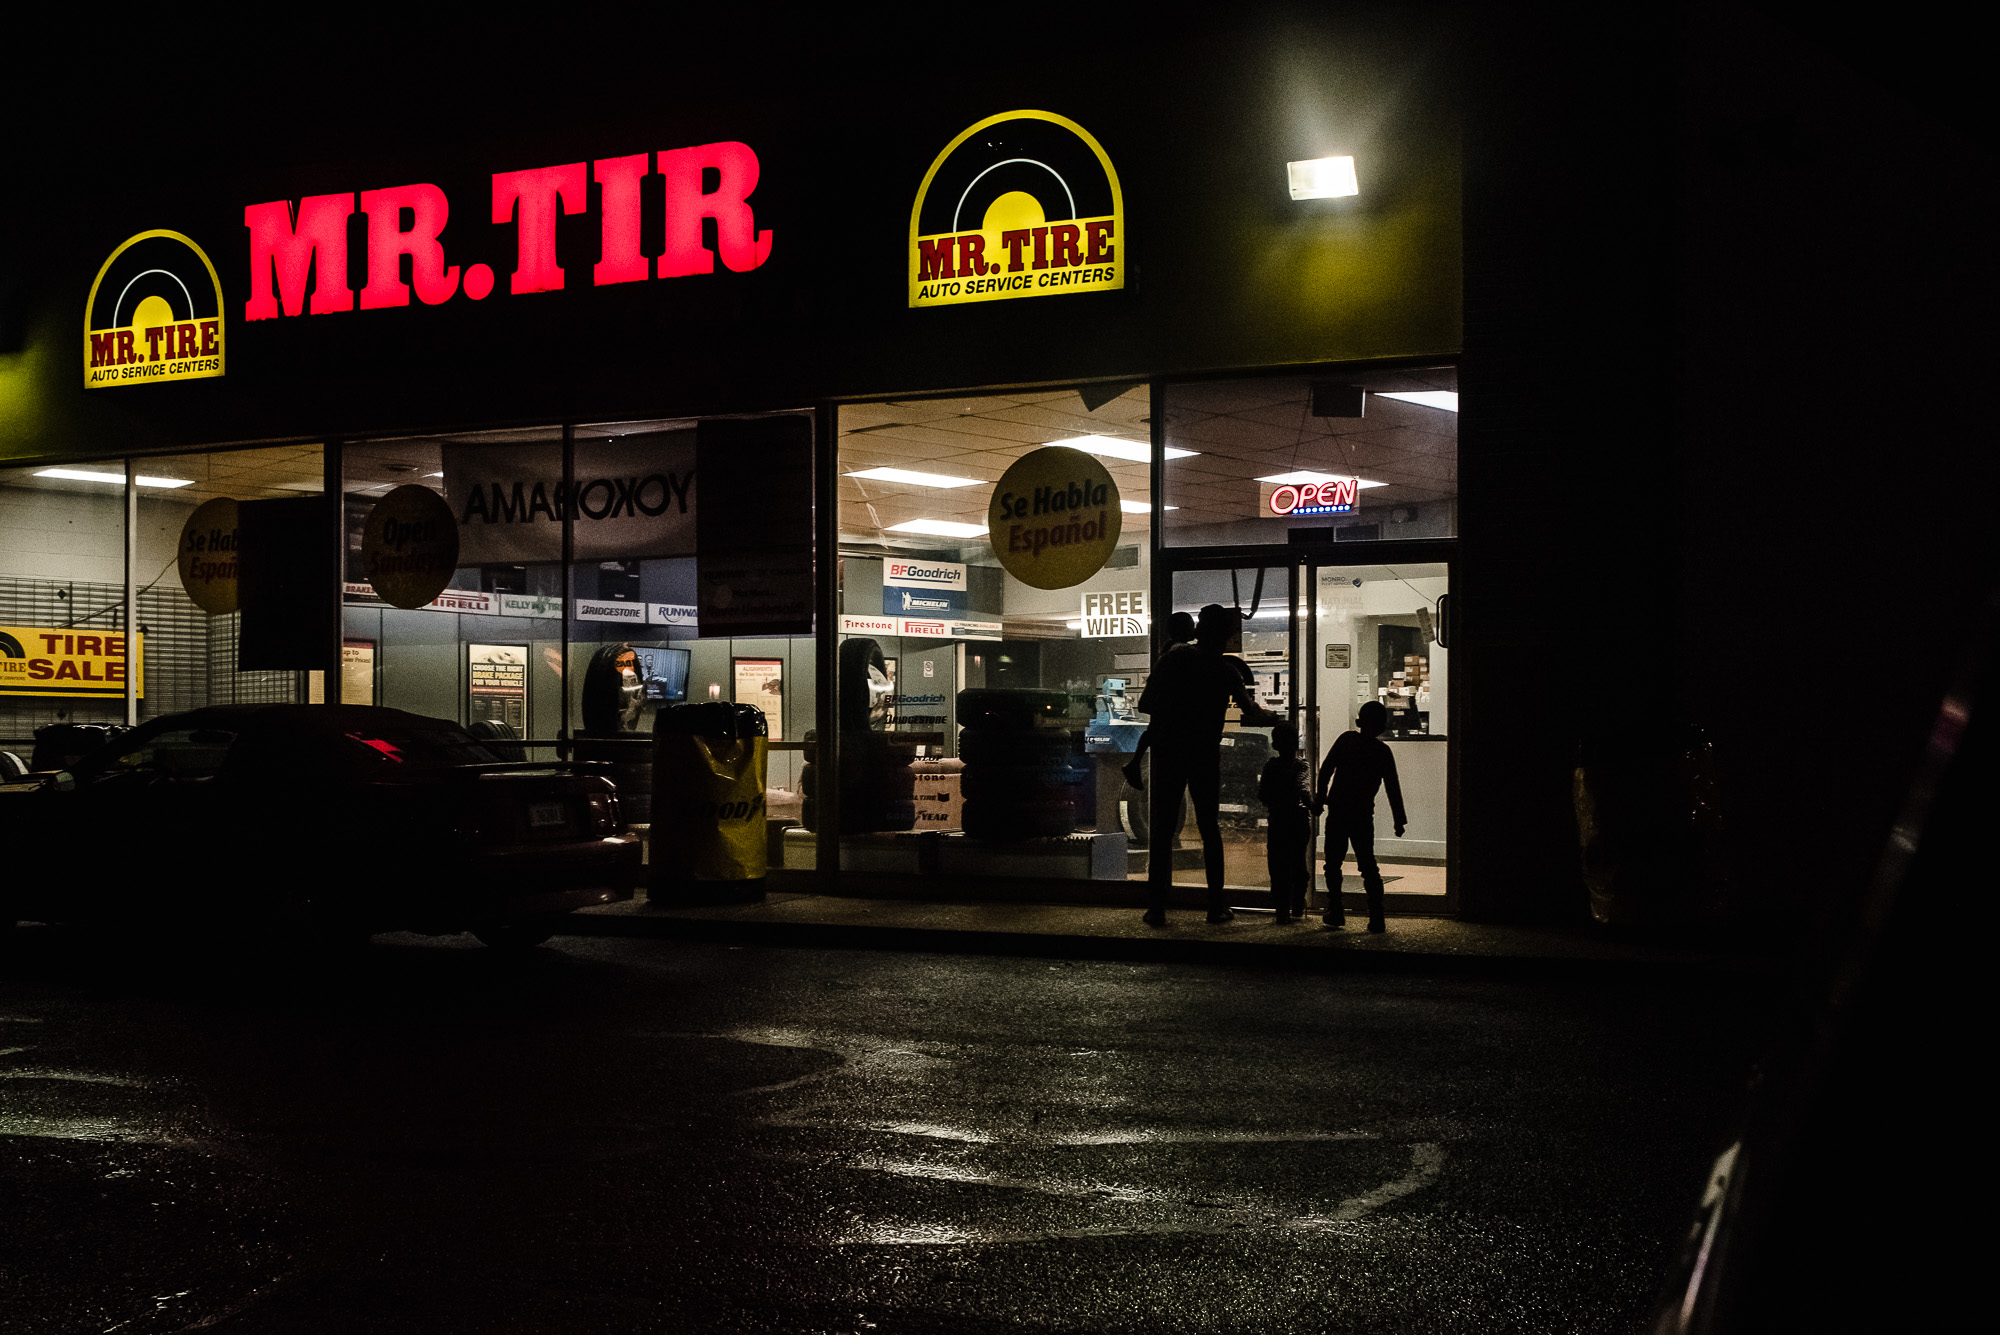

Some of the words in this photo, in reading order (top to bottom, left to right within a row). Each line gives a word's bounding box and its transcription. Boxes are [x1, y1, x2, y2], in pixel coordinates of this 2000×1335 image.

[918, 281, 961, 299] AUTO
[964, 275, 1033, 295] SERVICE
[1038, 266, 1115, 288] CENTERS
[90, 369, 120, 382] AUTO
[121, 363, 166, 380] SERVICE
[168, 357, 220, 375] CENTERS
[1000, 491, 1027, 521] Se
[1033, 478, 1108, 515] Habla
[1269, 479, 1359, 515] OPEN
[186, 529, 206, 552] Se
[208, 528, 242, 552] Hab
[383, 517, 437, 552] Open
[1007, 512, 1107, 557] Español
[188, 555, 243, 584] Españ
[889, 563, 962, 581] BFGoodrich
[1320, 576, 1347, 584] MONRO
[504, 600, 531, 610] KELLY
[580, 605, 641, 618] BRIDGESTONE
[911, 597, 950, 610] MICHELIN
[1085, 592, 1143, 616] FREE
[844, 618, 893, 631] Firestone
[904, 621, 945, 635] PIRELLI
[1085, 617, 1126, 636] WIFI
[39, 633, 128, 657] TIRE
[27, 657, 137, 682] SALE
[472, 671, 494, 679] BRAKE
[494, 672, 524, 680] PACKAGE
[484, 679, 501, 687] YOUR
[500, 679, 524, 687] VEHICLE
[884, 693, 946, 705] BFGoodrich
[883, 714, 948, 725] BRIDGESTONE
